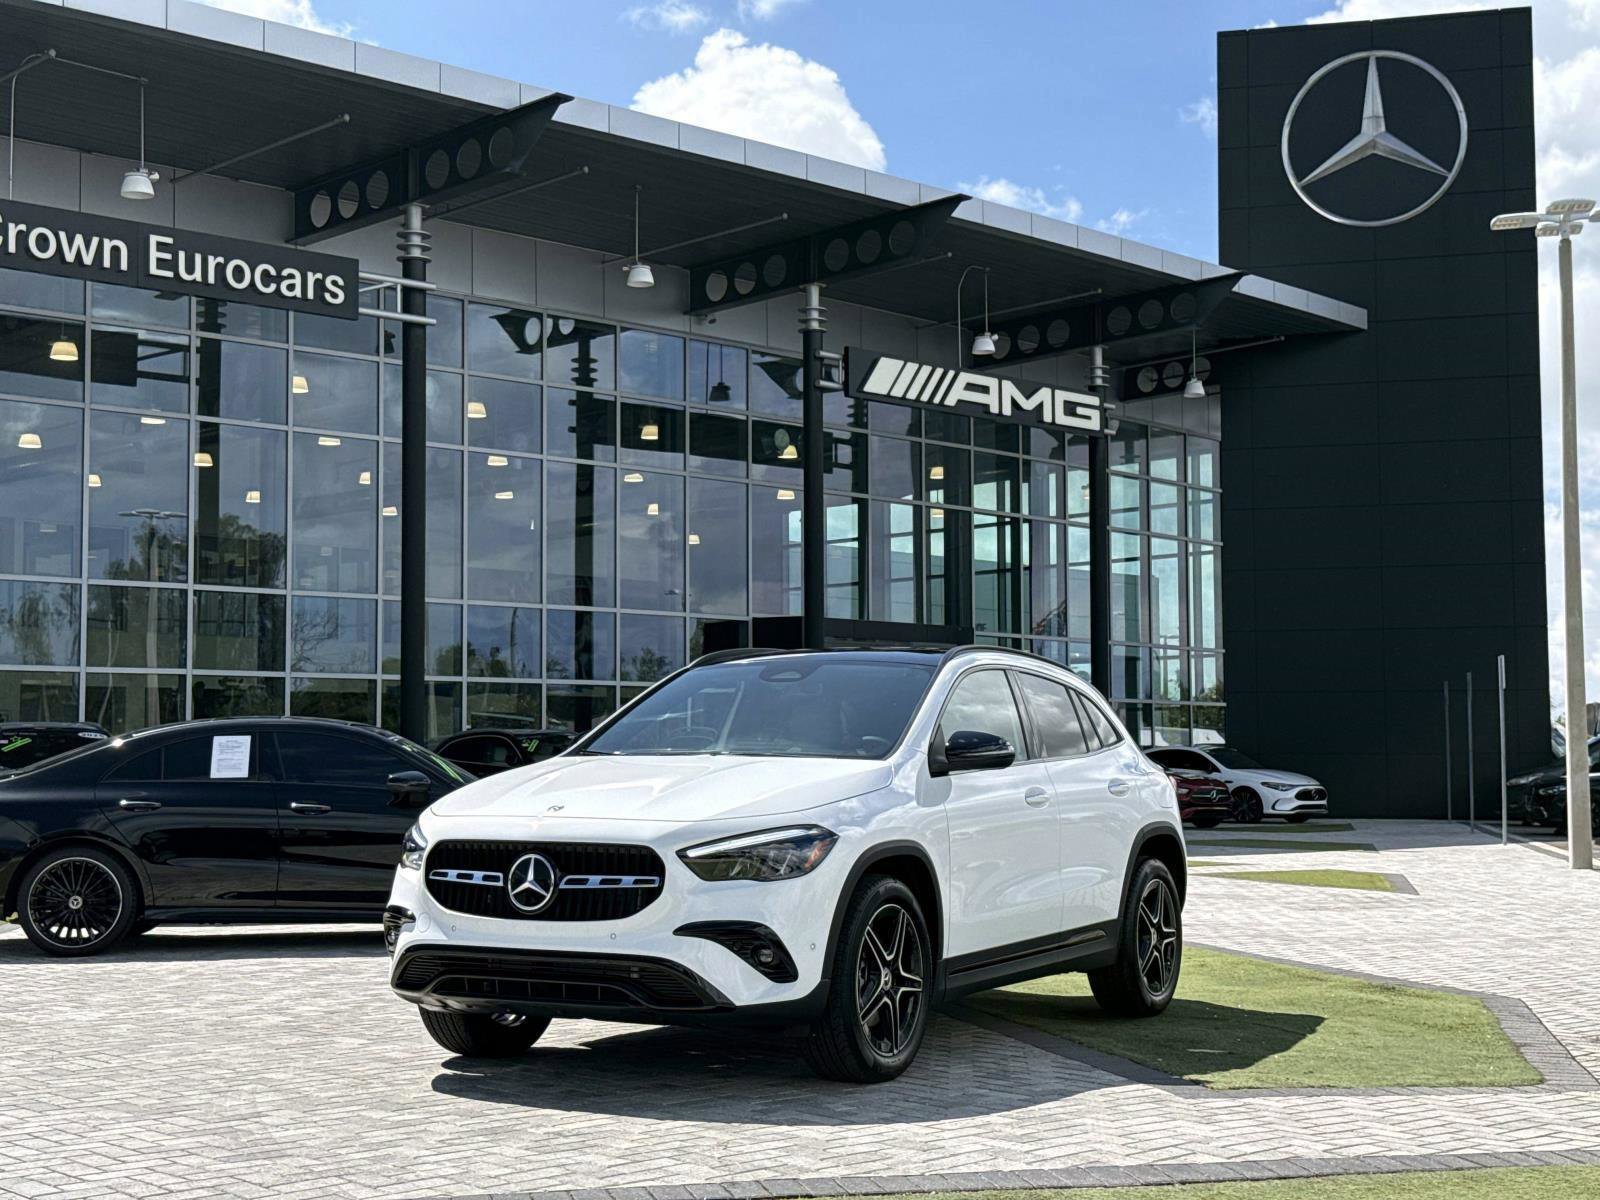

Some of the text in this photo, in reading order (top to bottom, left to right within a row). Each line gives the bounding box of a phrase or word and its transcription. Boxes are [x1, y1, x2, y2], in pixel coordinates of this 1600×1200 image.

[0, 213, 346, 305] rown Eurocars
[944, 371, 1100, 431] AMG
